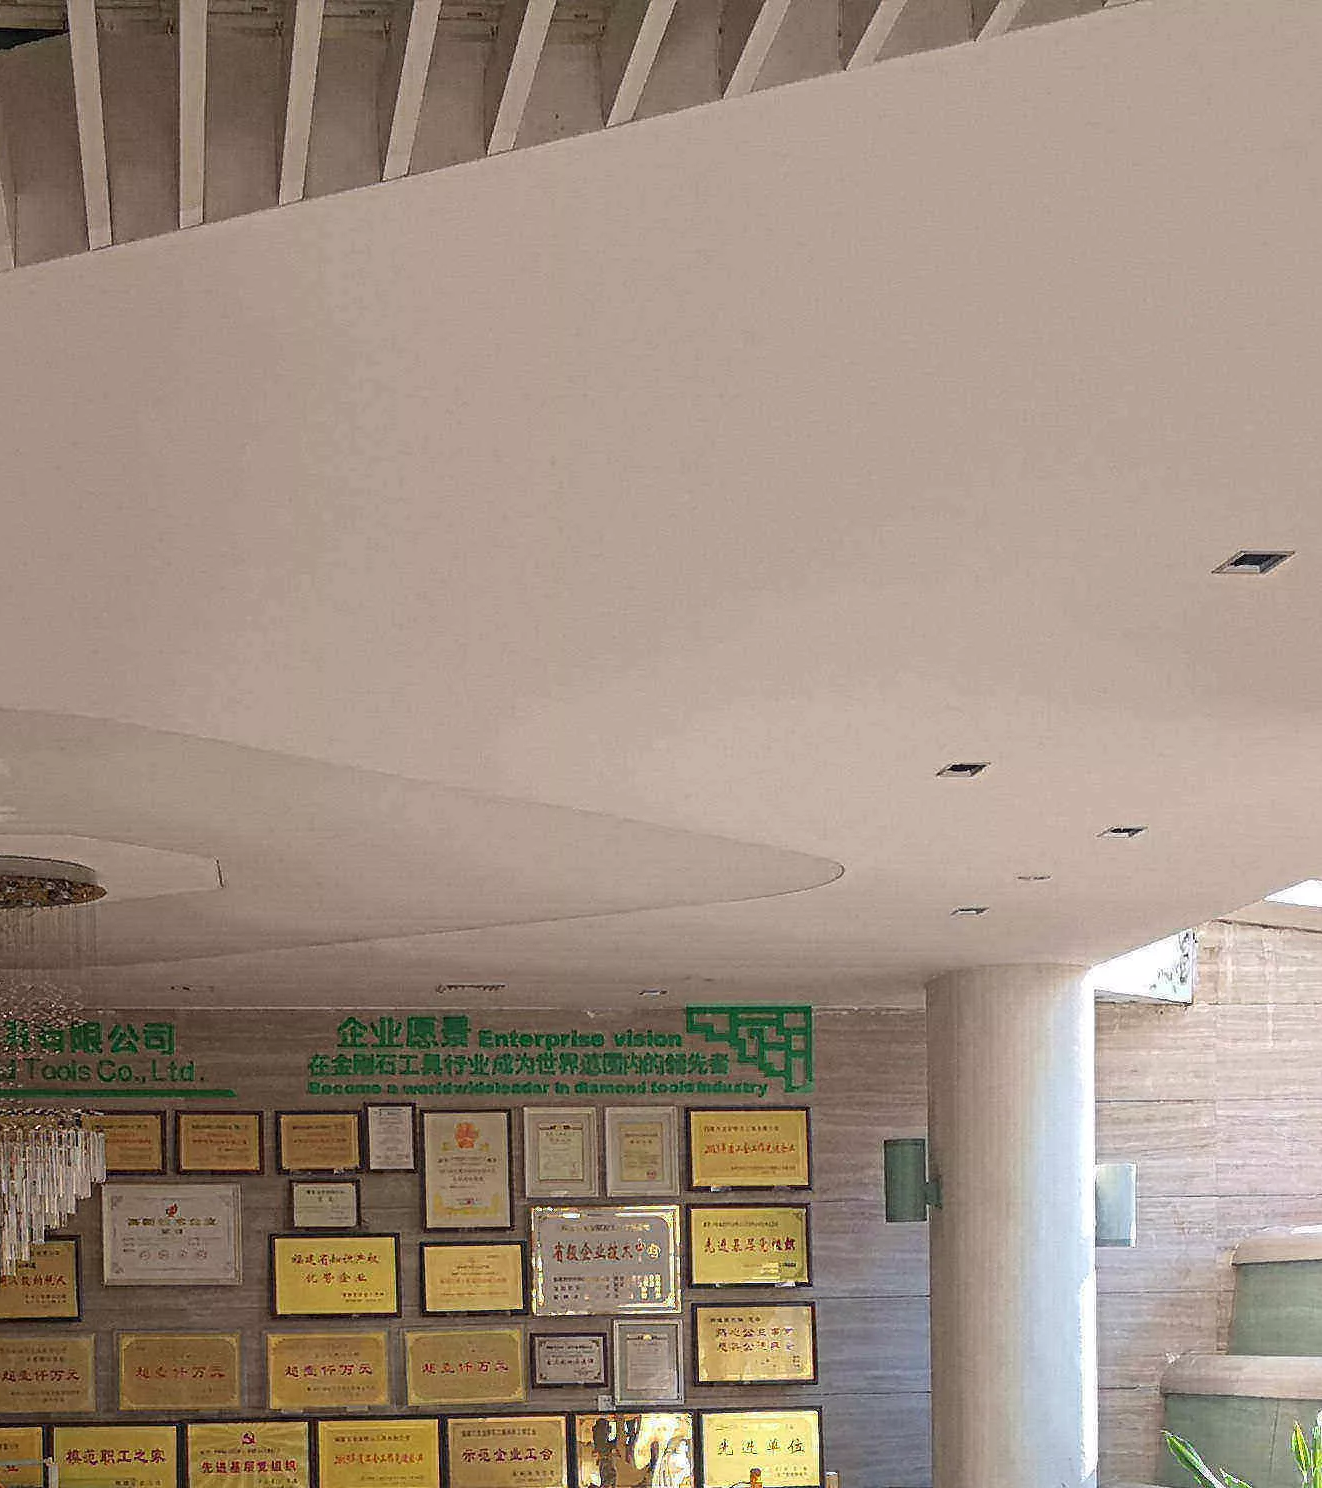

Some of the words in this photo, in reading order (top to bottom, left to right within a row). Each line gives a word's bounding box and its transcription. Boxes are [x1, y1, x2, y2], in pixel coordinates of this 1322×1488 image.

[336, 1016, 472, 1048] 企业愿景
[478, 1029, 604, 1054] Enterprise
[614, 1029, 682, 1048] vision
[24, 1058, 90, 1080] Tools
[308, 1081, 382, 1096] Become
[388, 1083, 400, 1096] a
[554, 1081, 571, 1096] in
[65, 1448, 168, 1467] 模范职工之家
[201, 1460, 298, 1475] 先进基层党组织
